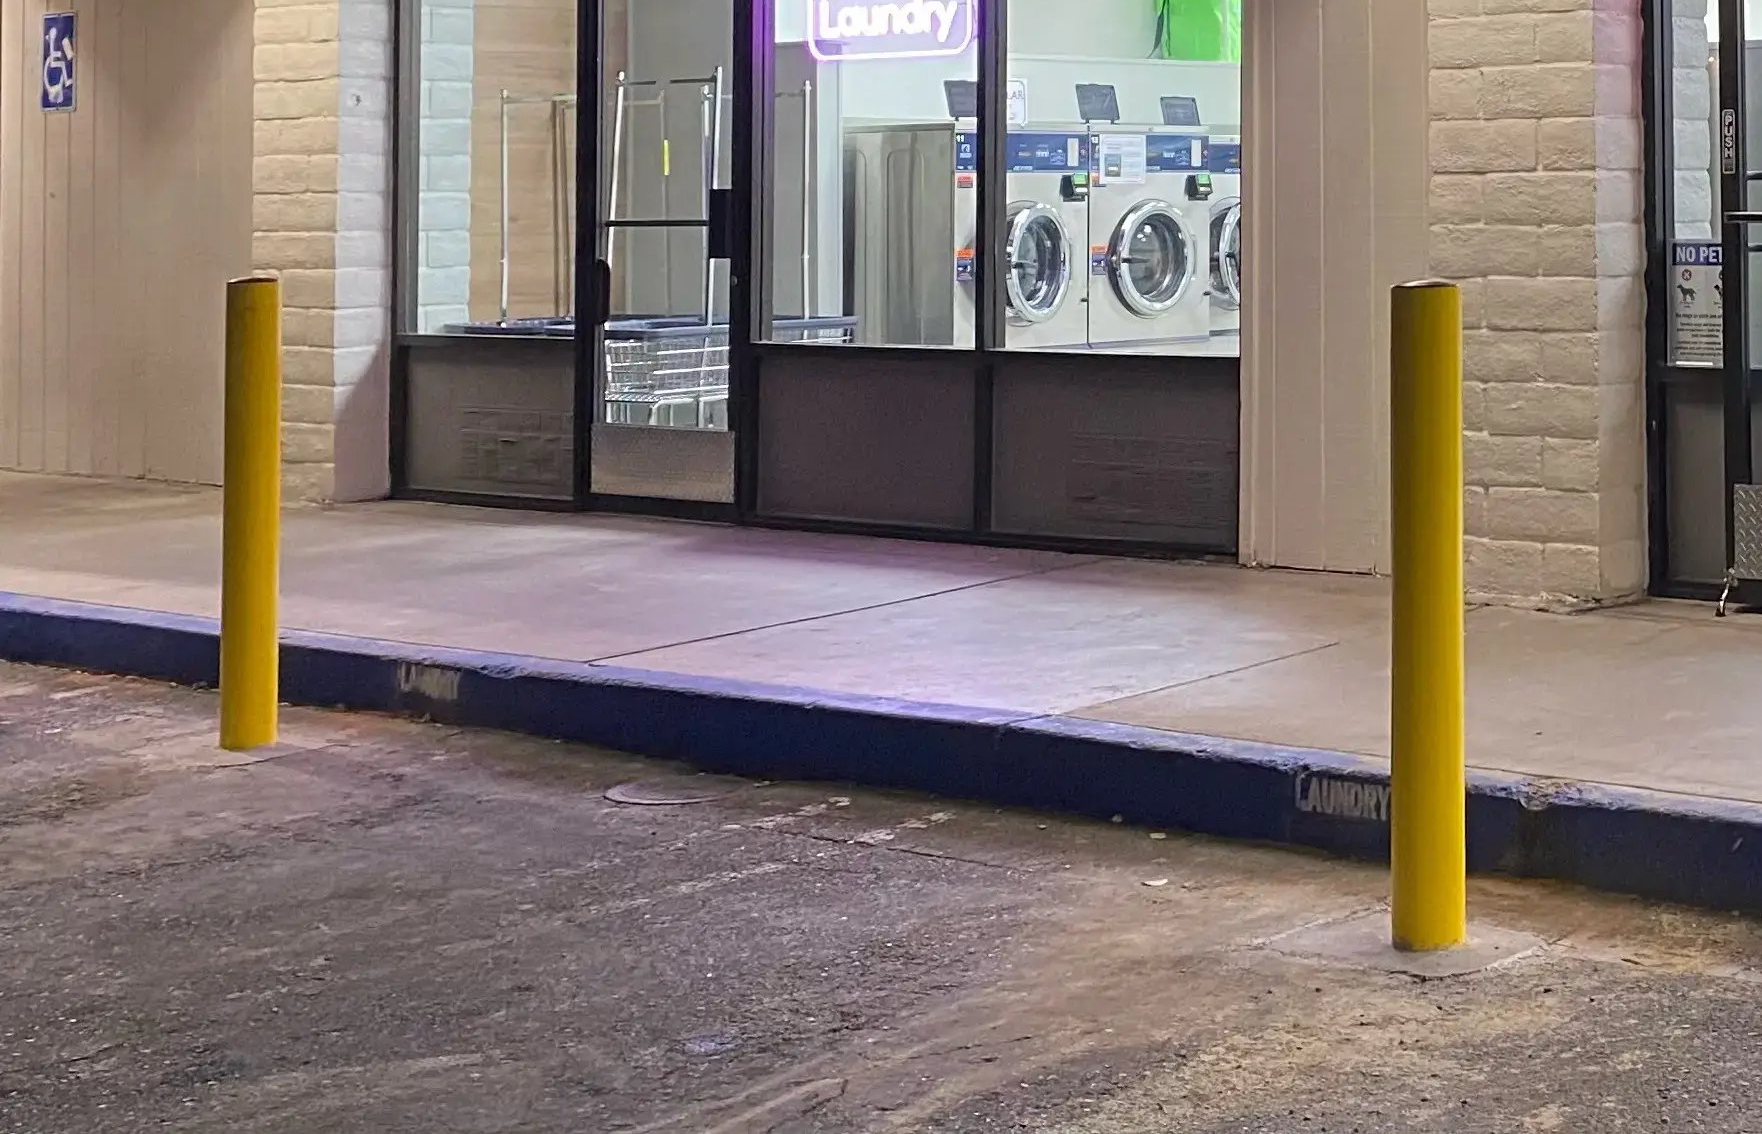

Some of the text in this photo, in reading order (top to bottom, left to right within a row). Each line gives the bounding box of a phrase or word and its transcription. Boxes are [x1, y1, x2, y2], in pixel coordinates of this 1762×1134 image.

[1724, 115, 1734, 158] PUSH
[1676, 246, 1697, 263] NO
[1294, 771, 1390, 821] LAUNDRY
